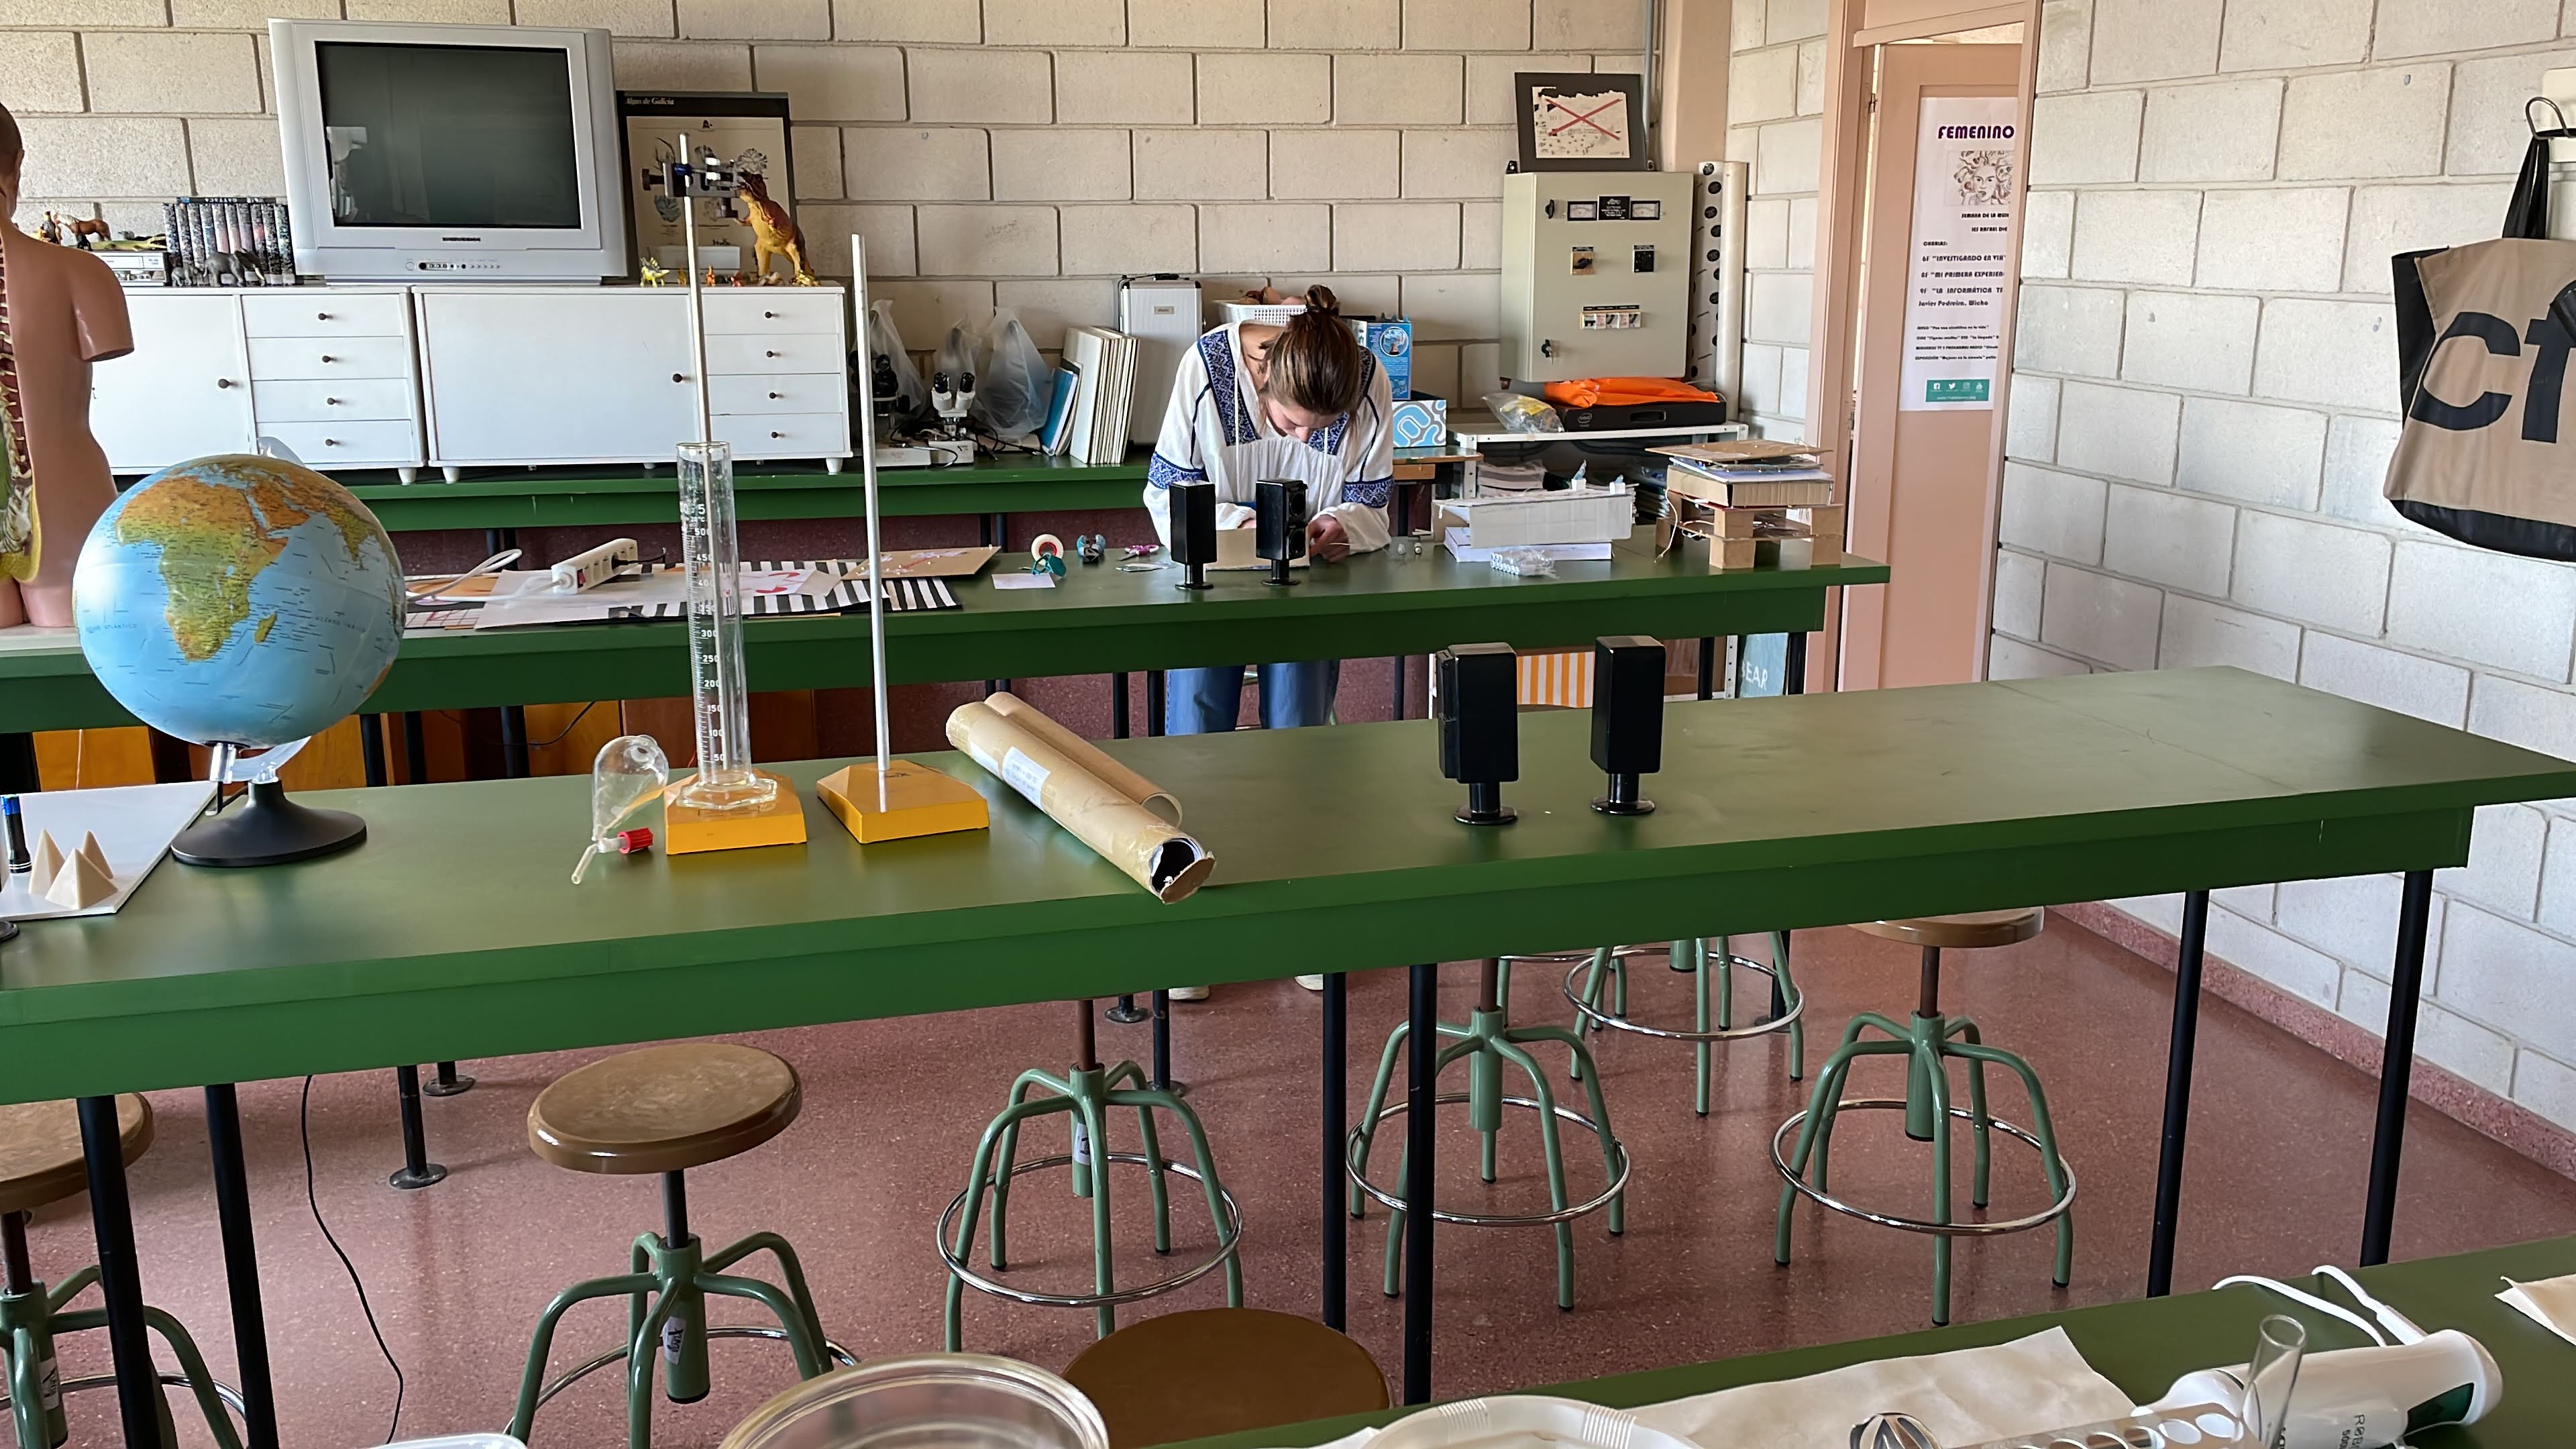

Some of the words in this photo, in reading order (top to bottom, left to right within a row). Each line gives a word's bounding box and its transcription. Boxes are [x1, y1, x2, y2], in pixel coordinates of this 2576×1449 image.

[651, 97, 674, 105] Galicia
[1938, 125, 2015, 139] FEMENINO
[1741, 660, 1768, 692] EAR
